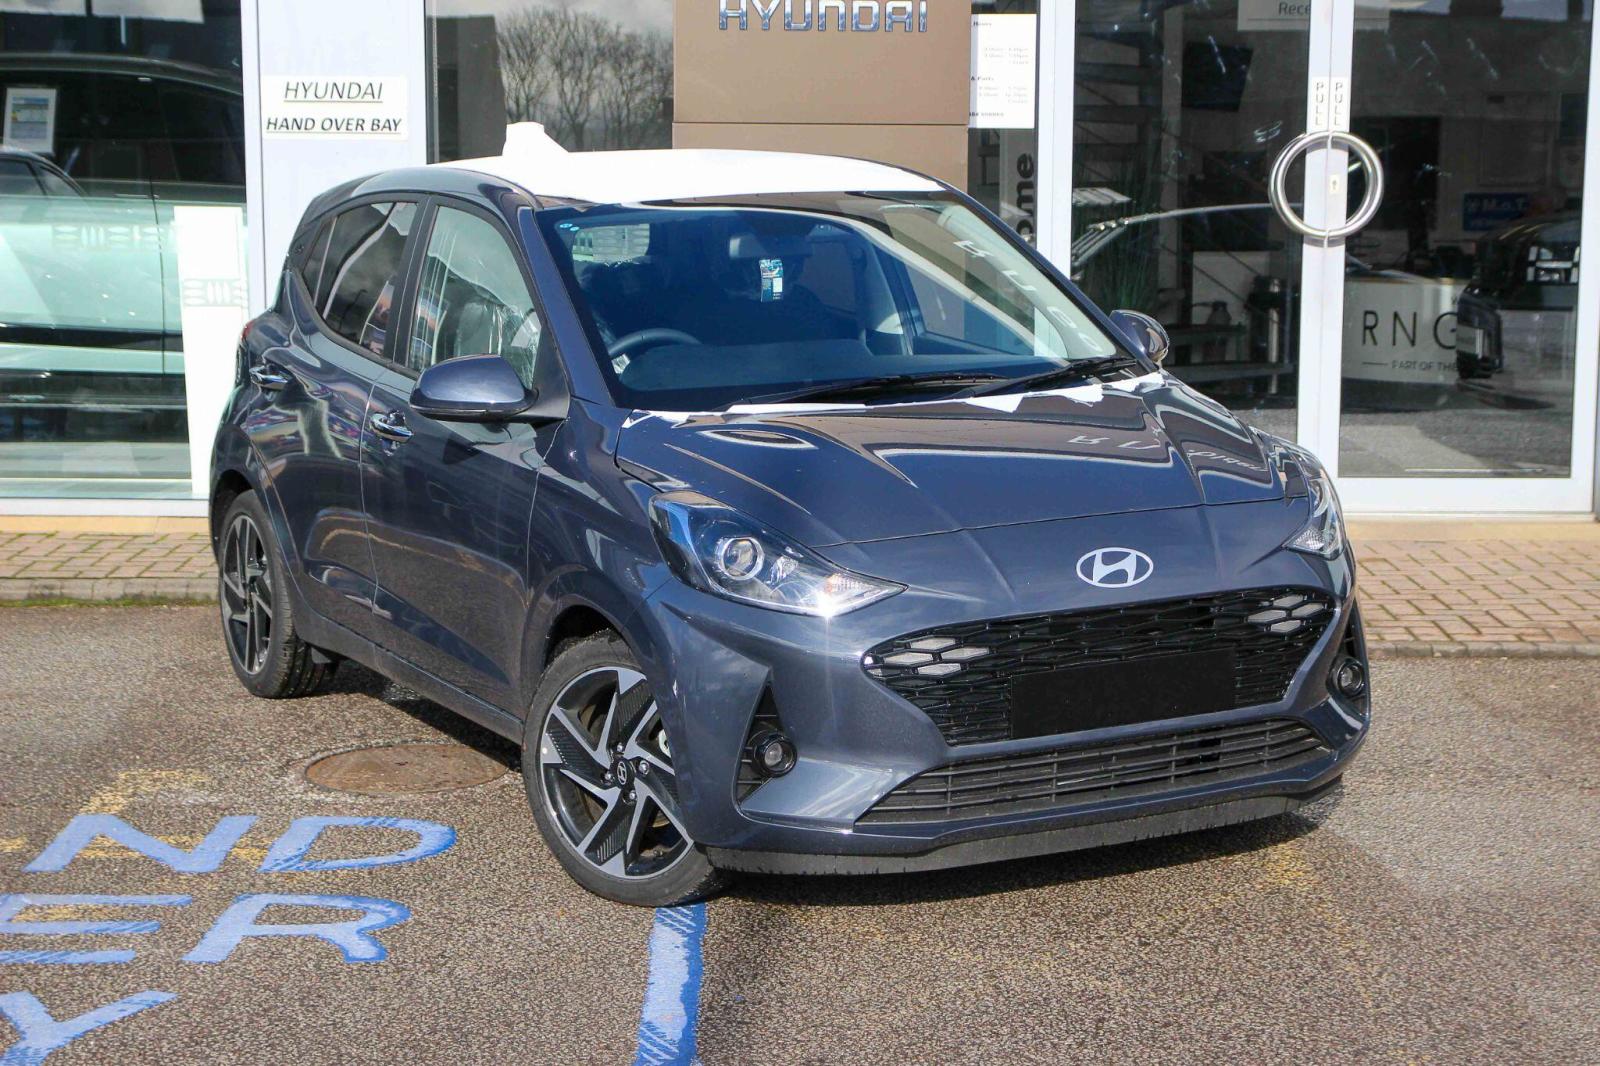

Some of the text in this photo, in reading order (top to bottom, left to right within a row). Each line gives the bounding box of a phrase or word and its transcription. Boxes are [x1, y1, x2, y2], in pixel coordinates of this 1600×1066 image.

[718, 0, 928, 32] HYUNDAI
[284, 81, 383, 99] HYUNDAI
[1315, 81, 1324, 126] PULL
[1334, 81, 1343, 126] PULL
[266, 117, 402, 132] HAND OVER BAY
